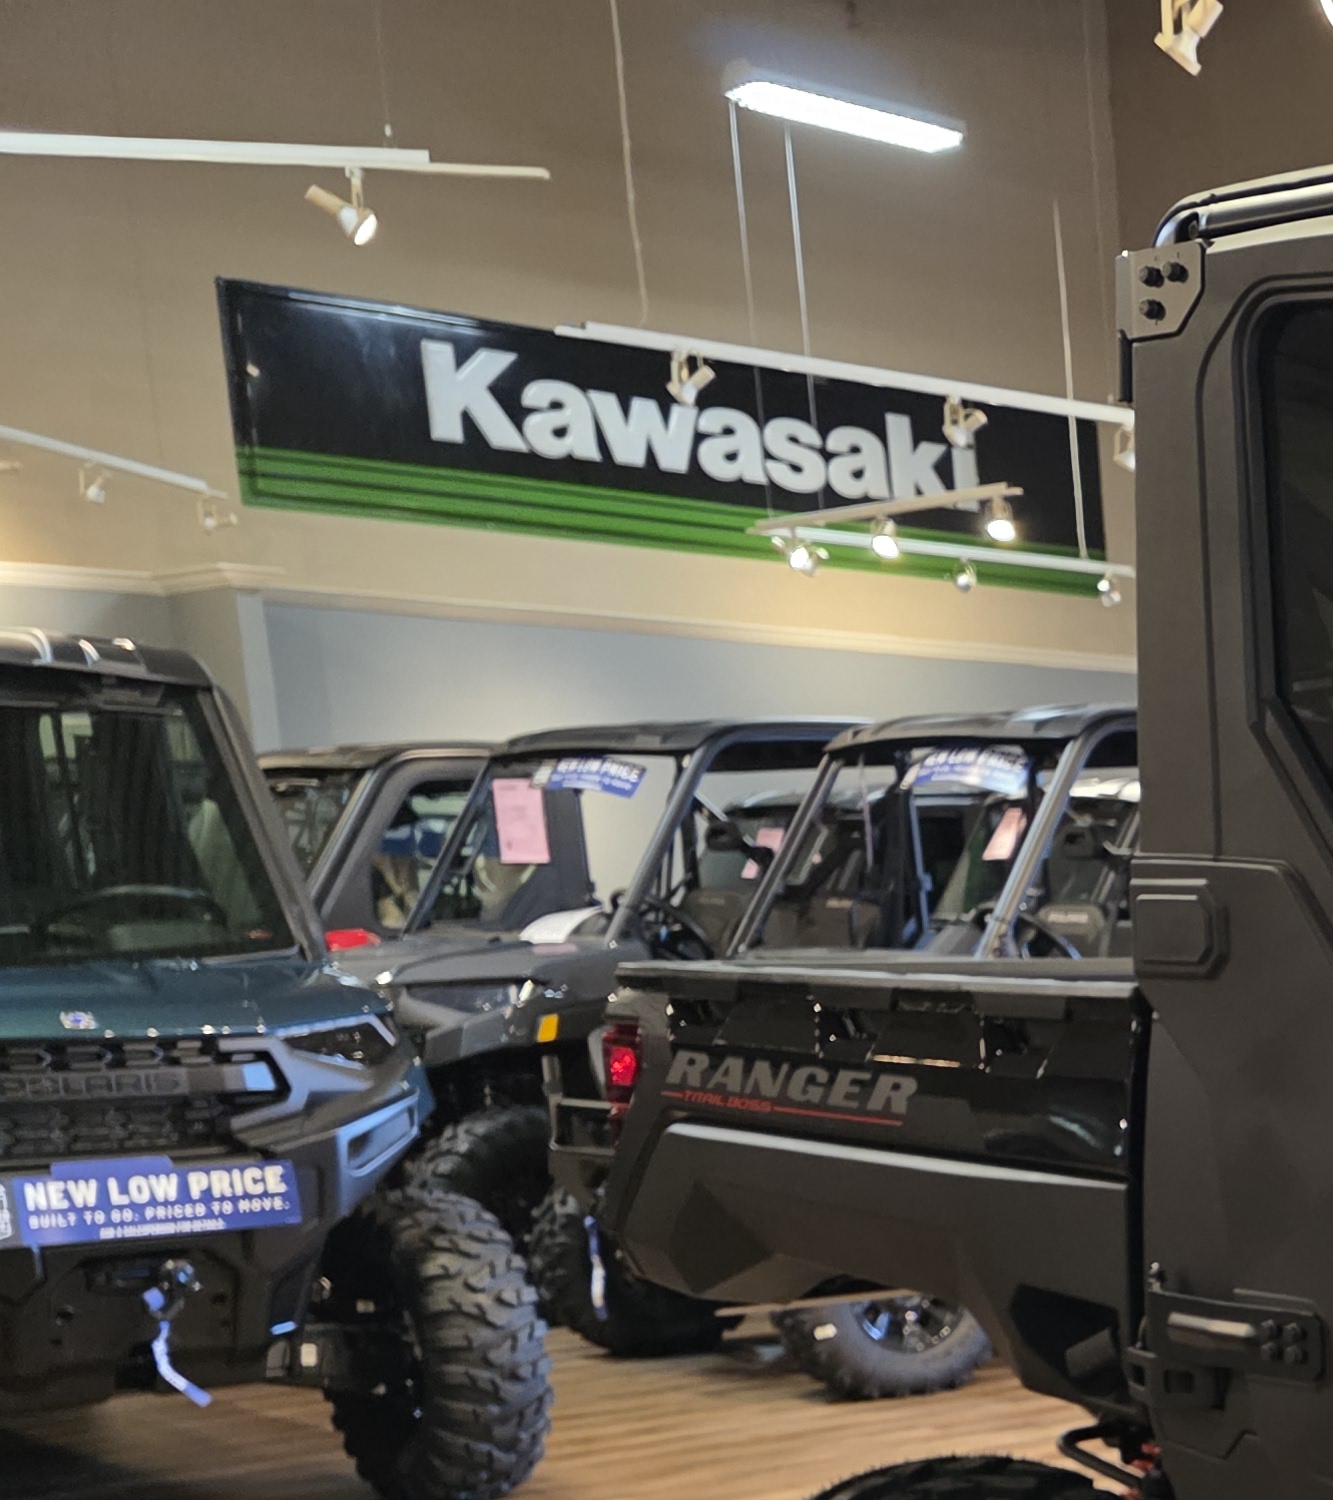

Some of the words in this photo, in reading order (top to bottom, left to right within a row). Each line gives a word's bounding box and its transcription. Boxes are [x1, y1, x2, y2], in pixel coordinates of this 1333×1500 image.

[420, 338, 979, 511] Kawasaki
[665, 1050, 918, 1114] RANGER
[23, 1178, 97, 1211] NEW
[107, 1173, 178, 1206] LOW
[187, 1165, 288, 1199] PRICE
[28, 1210, 77, 1230] BUILT
[83, 1209, 103, 1225] TO
[144, 1202, 206, 1221] PRICED
[211, 1200, 234, 1216] TO
